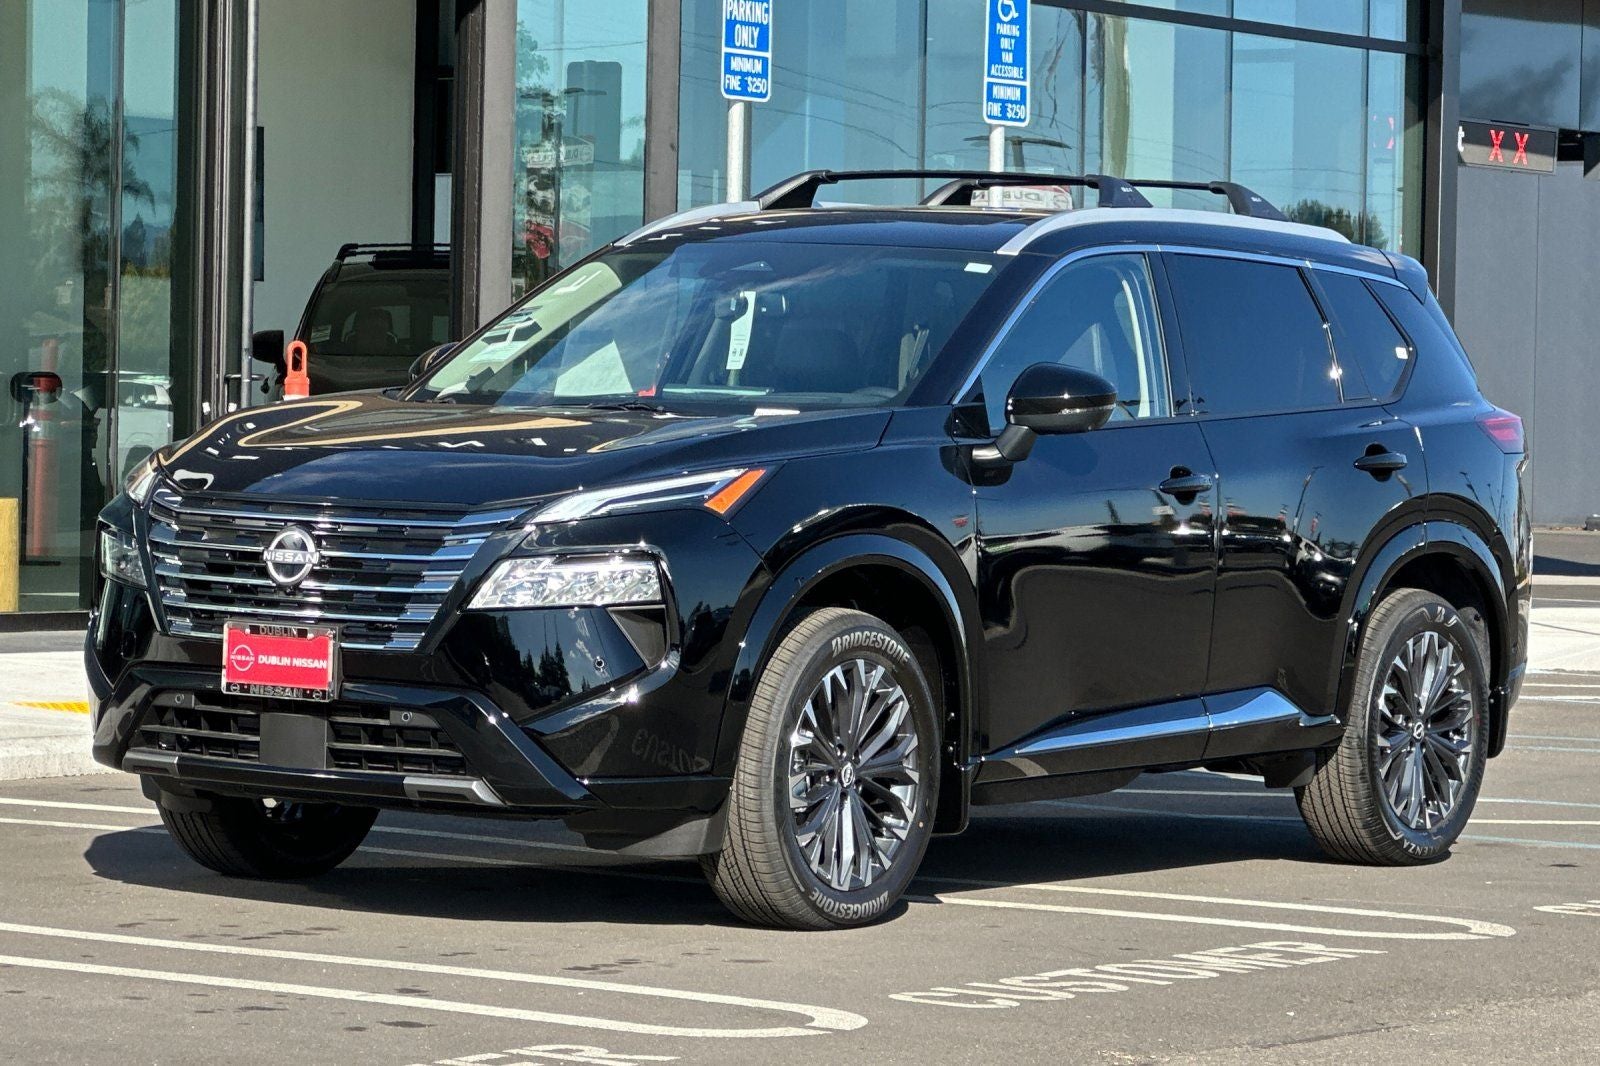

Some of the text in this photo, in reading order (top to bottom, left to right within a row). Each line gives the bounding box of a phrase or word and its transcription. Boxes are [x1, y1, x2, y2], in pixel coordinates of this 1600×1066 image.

[727, 0, 768, 25] PARKING
[735, 24, 759, 48] ONLY
[996, 23, 1020, 37] PARKING
[1000, 37, 1015, 50] ONLY
[730, 56, 762, 74] MINIMUM
[1001, 52, 1013, 63] VAN
[991, 64, 1023, 79] ACCESSIBLE
[725, 74, 767, 94] FINE $250
[992, 85, 1020, 101] MINIMUM
[987, 102, 1025, 119] FINE $250
[263, 550, 319, 564] NISSAN
[259, 625, 298, 638] DUBLIN
[831, 630, 911, 664] BRIDGESTONE
[230, 654, 255, 662] NISSAN
[258, 655, 328, 670] DUBLIN NISSAN
[249, 683, 304, 698] NISSAN
[808, 887, 890, 919] BRIDGESTONE
[888, 940, 1388, 1009] CUSTOMER
